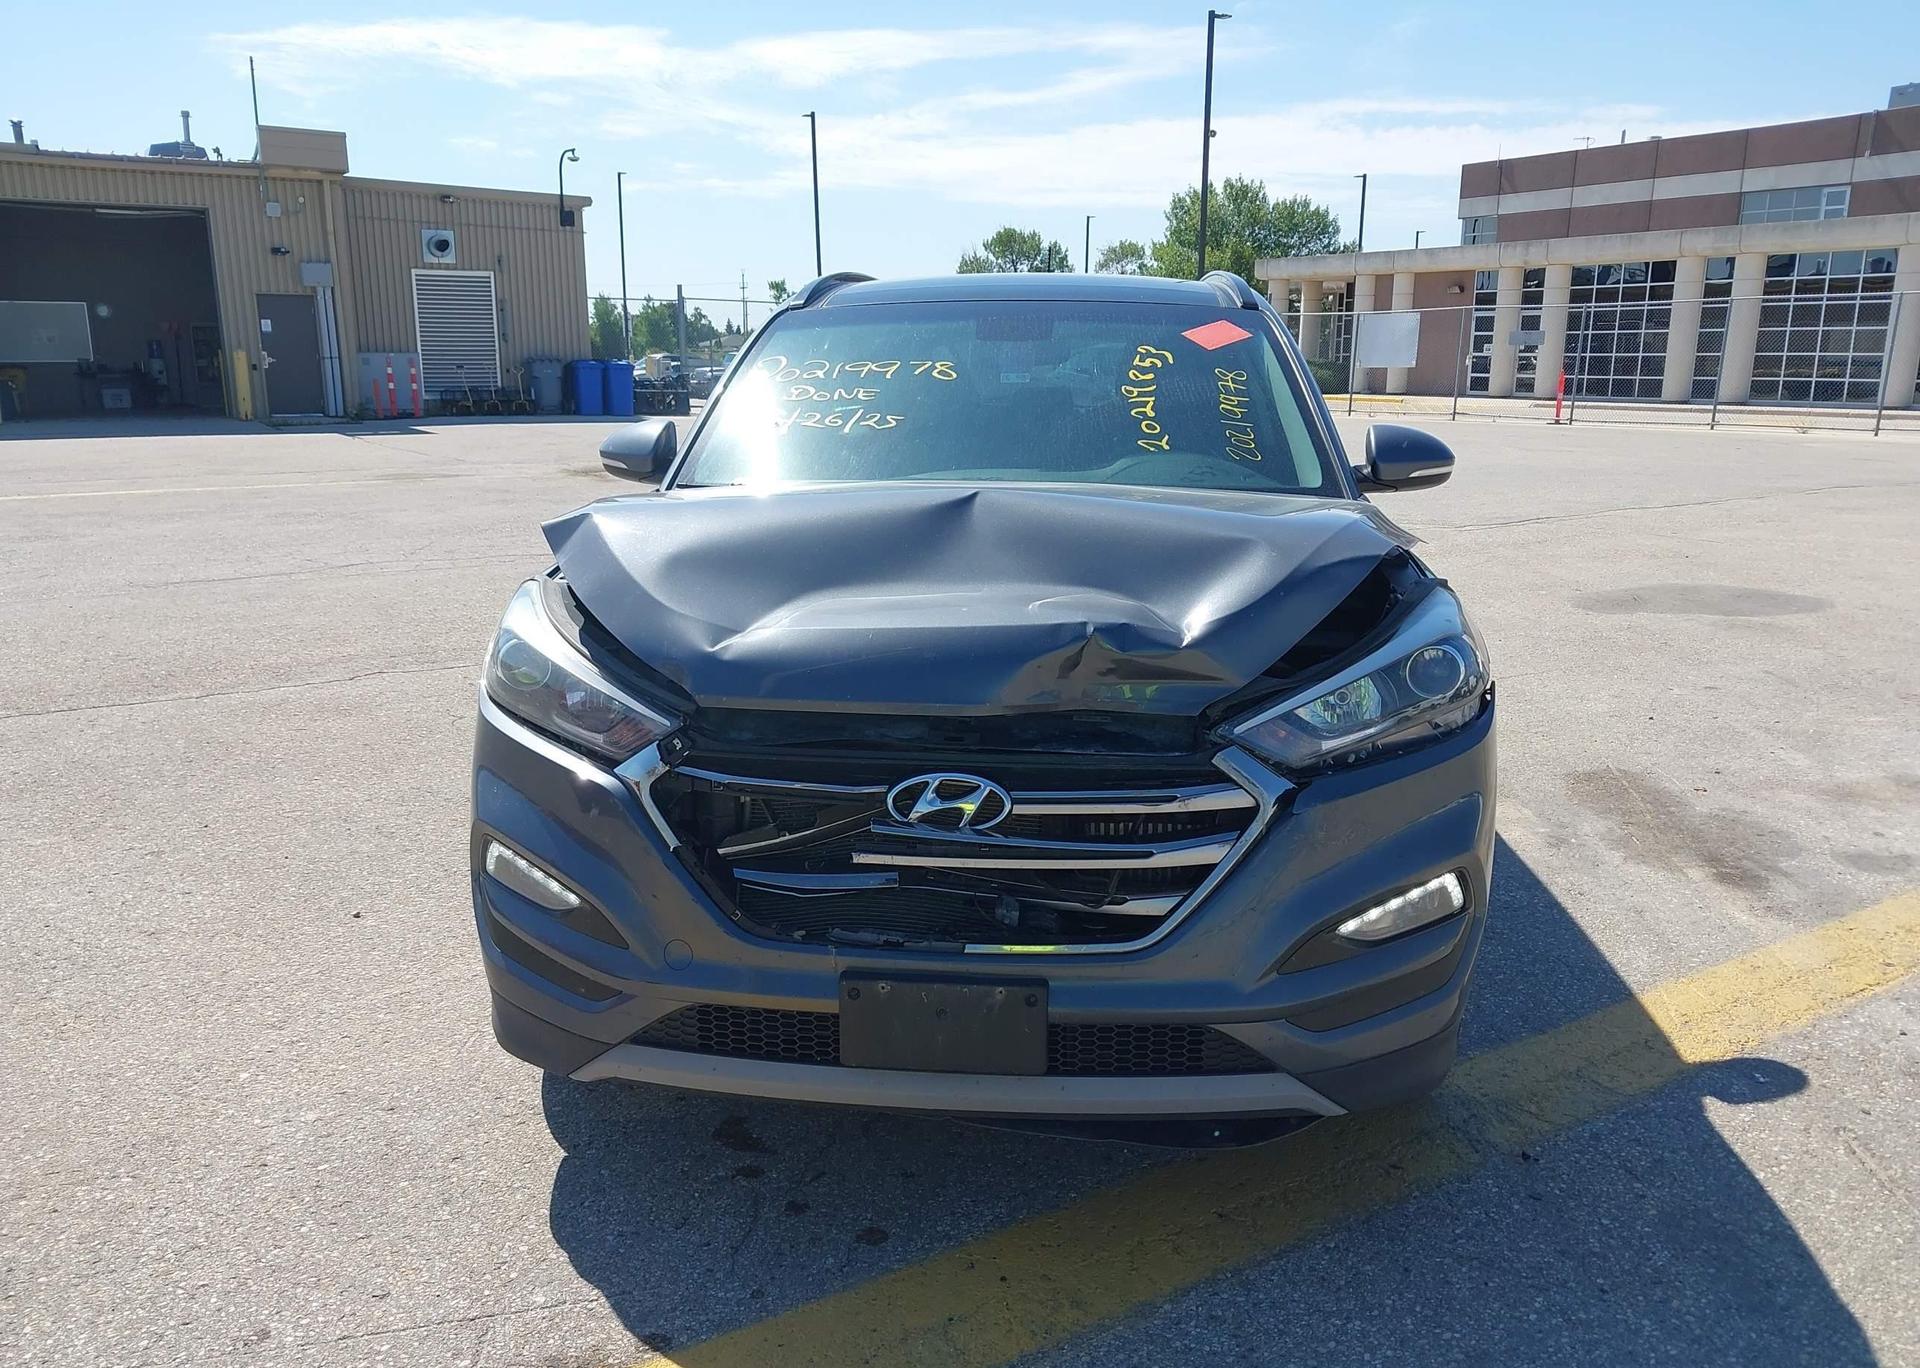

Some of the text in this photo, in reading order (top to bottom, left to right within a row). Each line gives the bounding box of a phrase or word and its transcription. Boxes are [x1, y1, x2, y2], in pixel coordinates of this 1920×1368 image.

[783, 385, 880, 401] DONE
[775, 407, 905, 434] /26/25
[1214, 367, 1262, 461] 20219978
